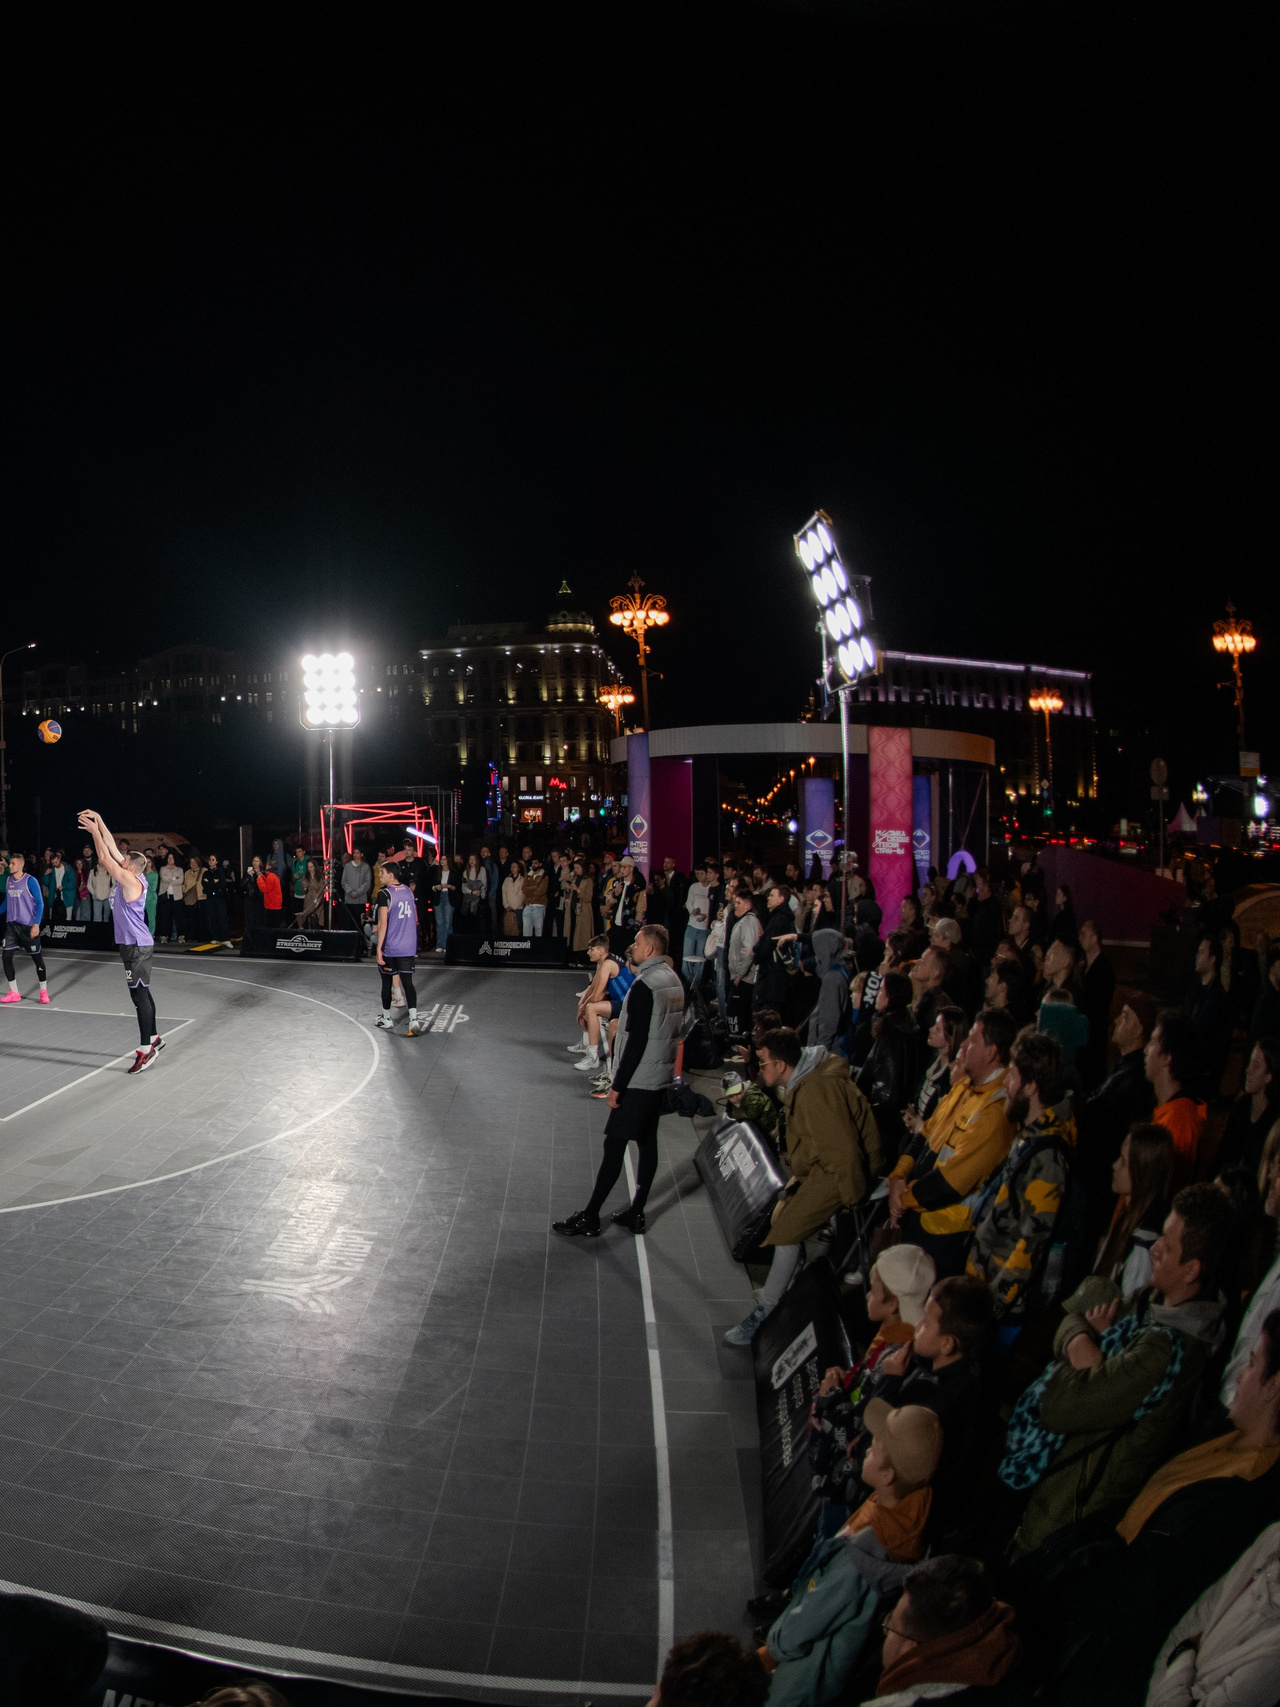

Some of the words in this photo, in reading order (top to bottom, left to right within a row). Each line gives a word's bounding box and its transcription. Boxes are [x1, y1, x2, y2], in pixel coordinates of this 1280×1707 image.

[397, 901, 412, 919] 24
[493, 940, 531, 949] МОСКОВСКИЙ
[493, 948, 512, 956] СПОРТ
